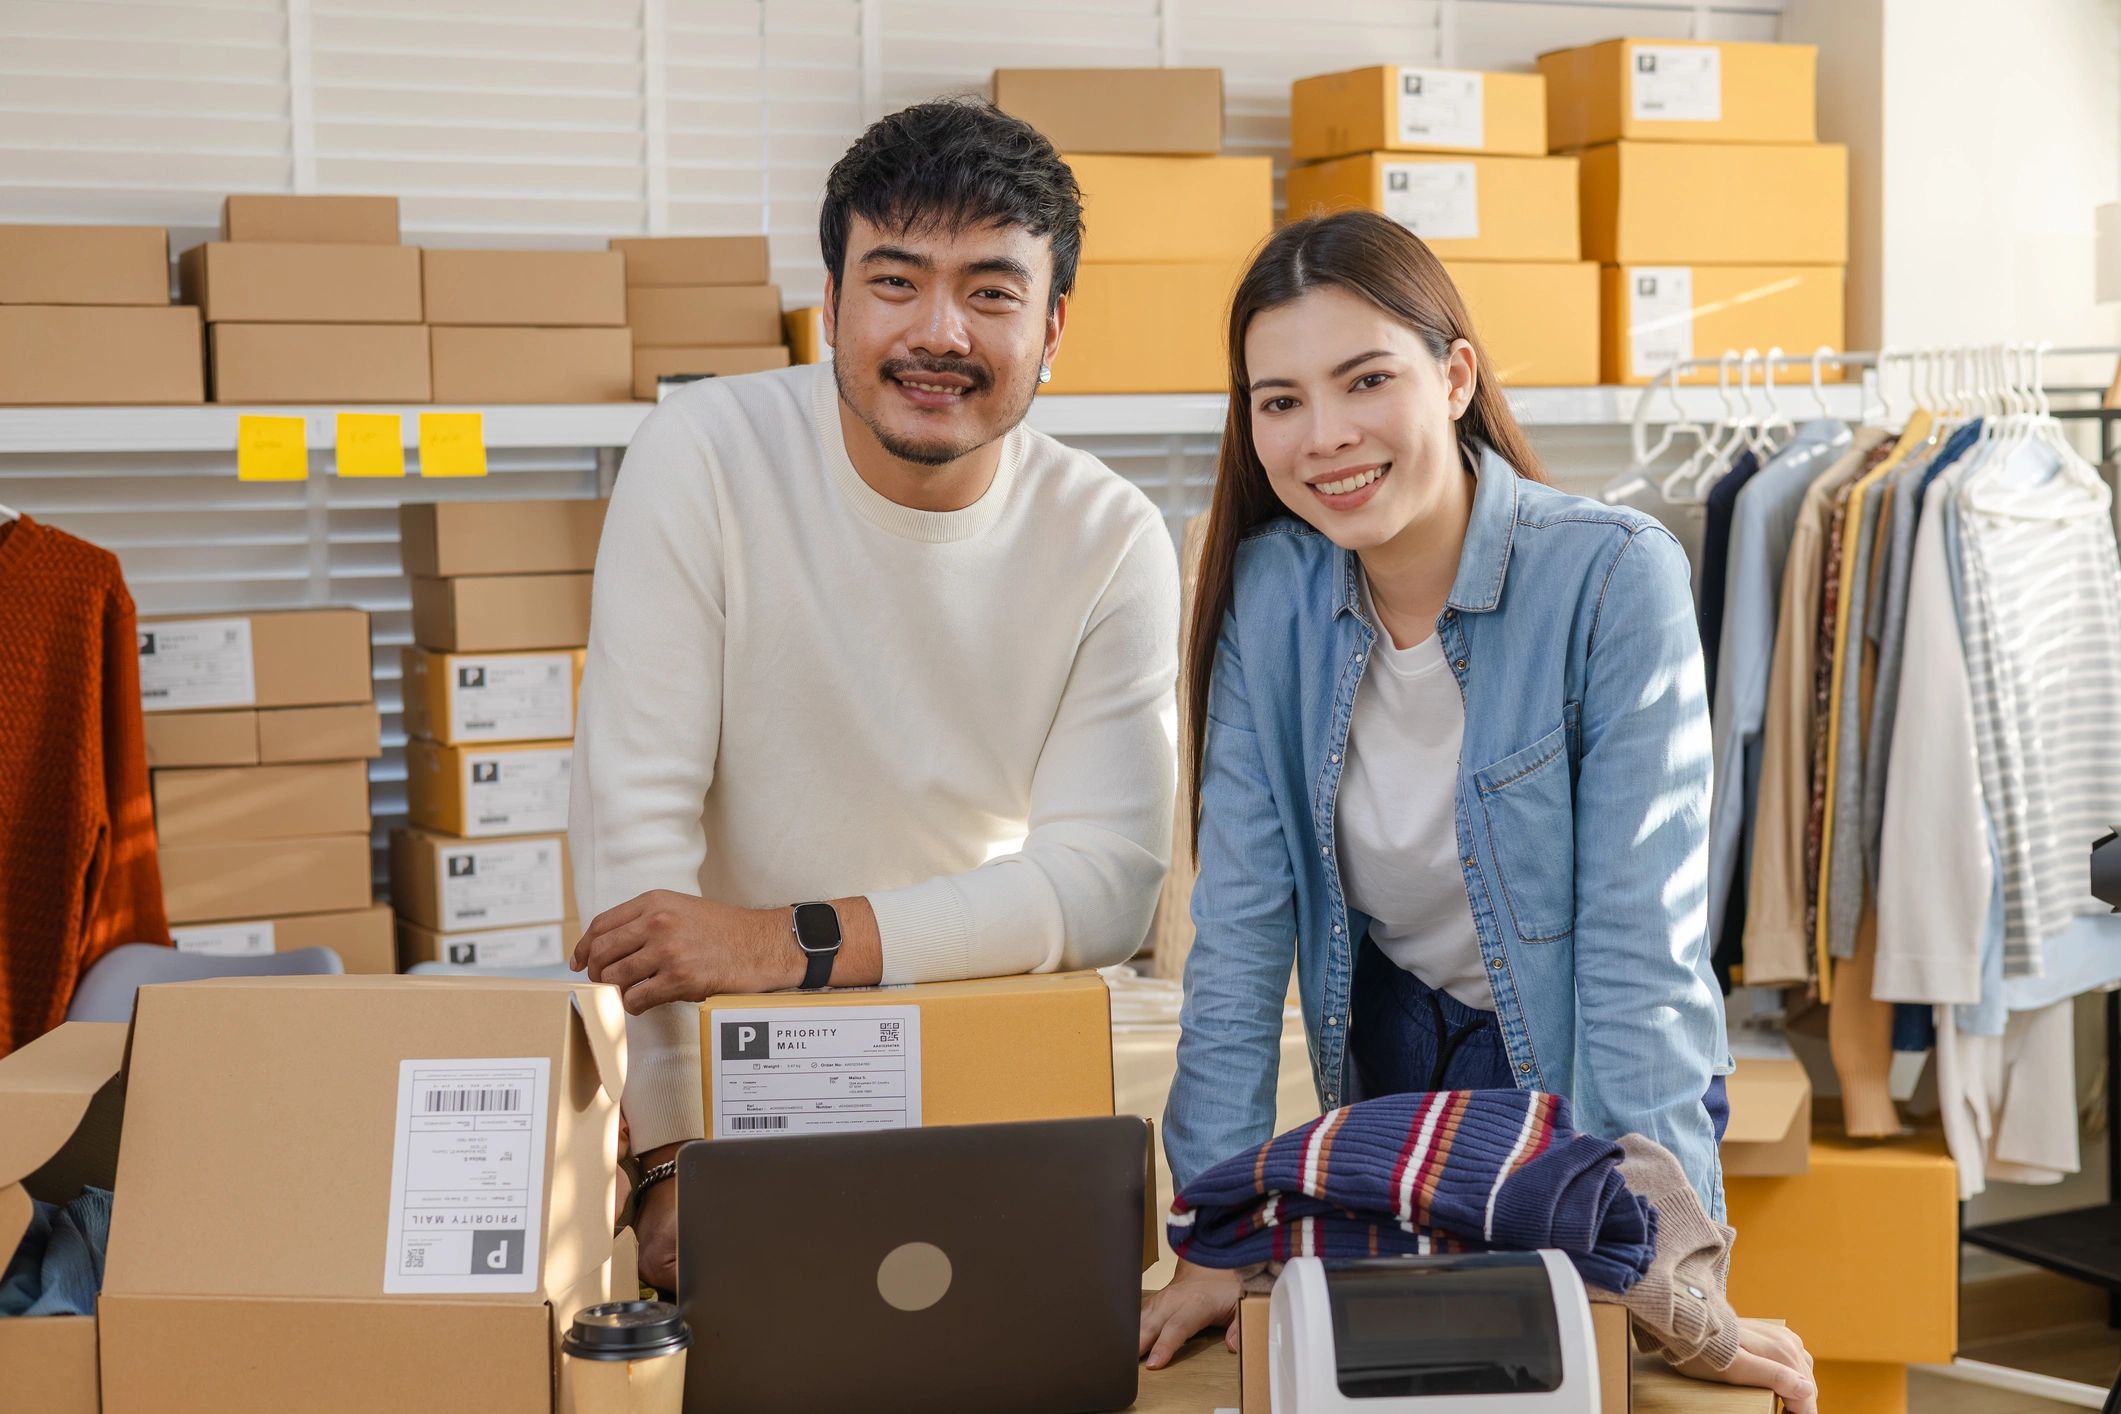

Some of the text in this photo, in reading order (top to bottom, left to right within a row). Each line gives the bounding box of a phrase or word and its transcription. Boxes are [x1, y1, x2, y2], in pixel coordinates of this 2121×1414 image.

[465, 668, 480, 686] P
[479, 763, 493, 782] P
[455, 856, 470, 875] P
[456, 944, 470, 963] P
[738, 1026, 757, 1052] P
[776, 1028, 838, 1038] PRIORITY
[777, 1041, 807, 1050] MAIL
[412, 1214, 518, 1225] PRIORITY MAIL
[486, 1239, 509, 1269] P
